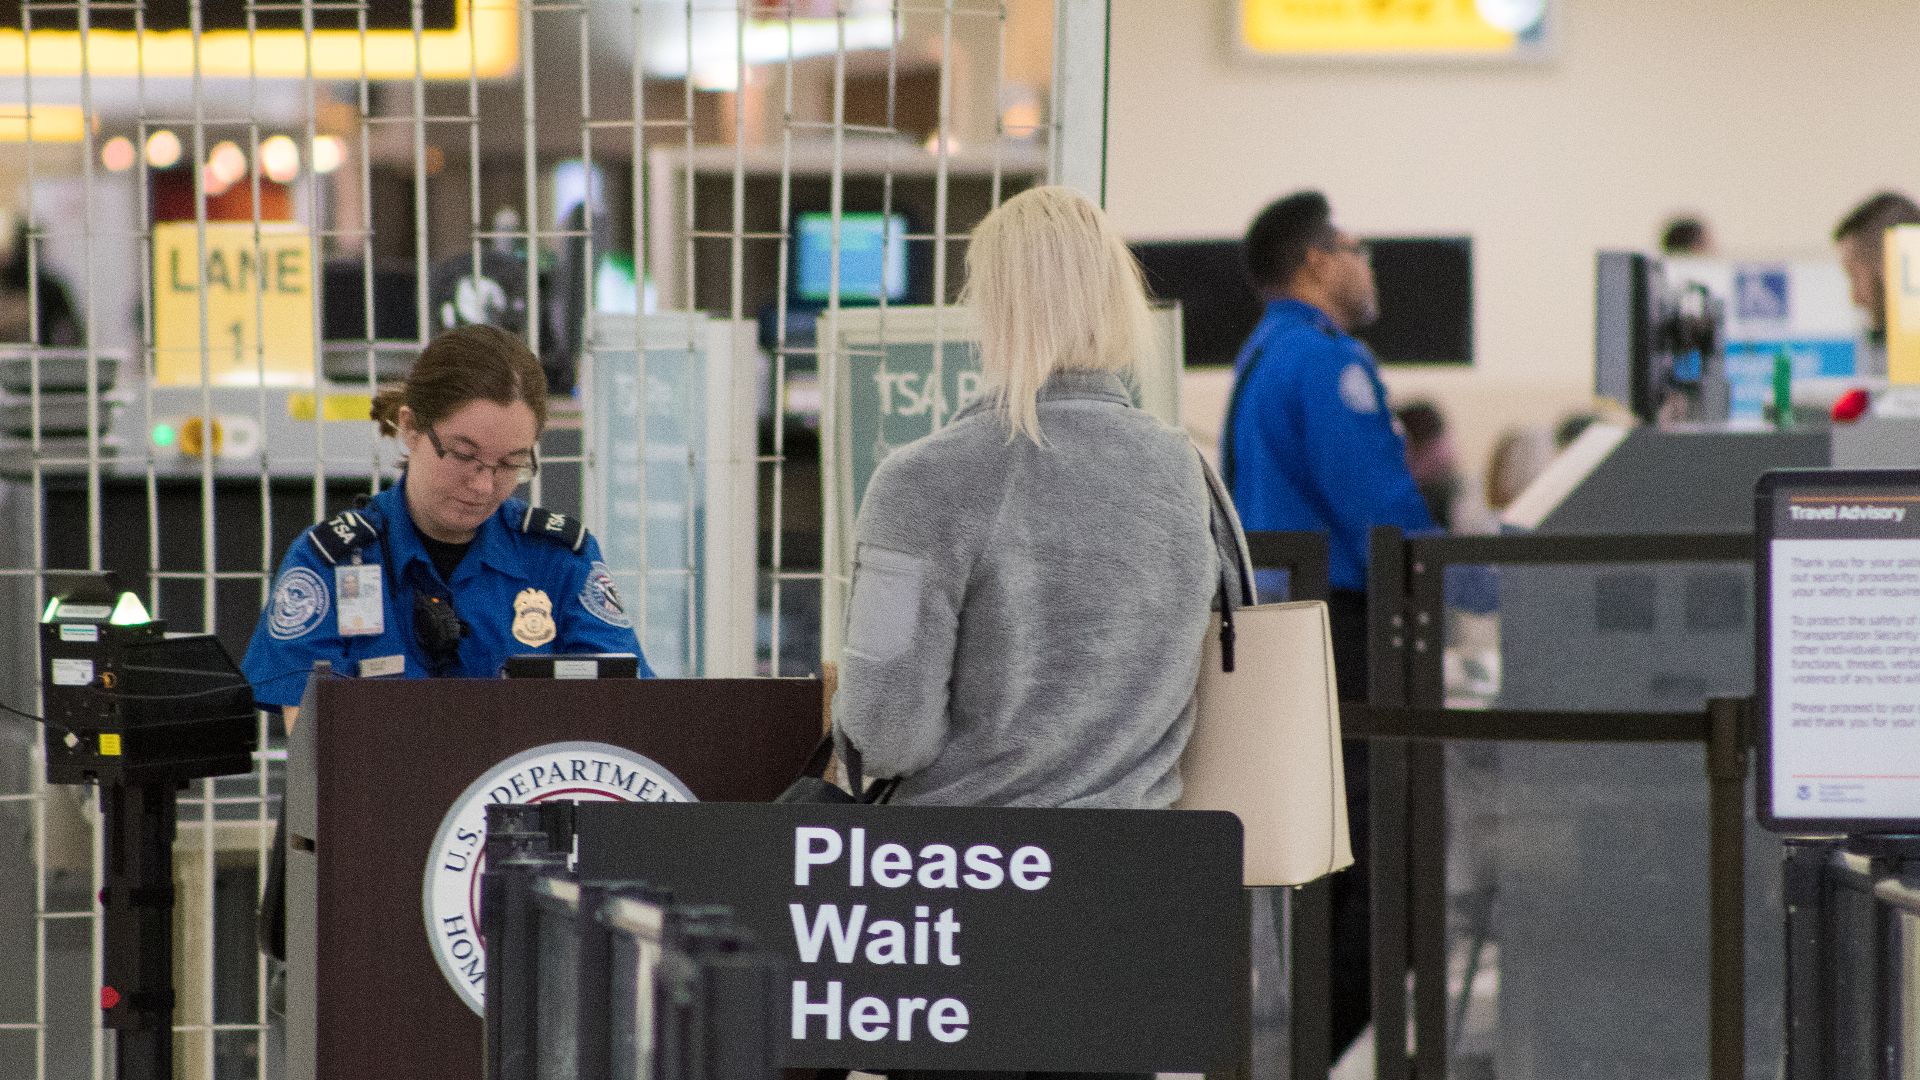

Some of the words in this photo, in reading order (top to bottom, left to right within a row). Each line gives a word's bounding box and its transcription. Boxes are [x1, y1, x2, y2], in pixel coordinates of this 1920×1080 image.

[170, 248, 303, 293] LANE
[226, 320, 244, 361] 1
[872, 371, 950, 416] TSA
[957, 370, 983, 412] P
[544, 512, 567, 532] TSA
[1789, 505, 1837, 520] Travel
[1838, 505, 1906, 523] Advisory
[327, 515, 358, 545] TSA
[1791, 557, 1824, 568] Thank
[1827, 559, 1848, 569] you
[1850, 557, 1864, 568] for
[1870, 559, 1893, 569] your
[1812, 572, 1853, 583] security
[1857, 572, 1918, 583] procedures
[1791, 588, 1814, 597] your
[1819, 586, 1852, 597] safety
[1856, 586, 1876, 596] and
[1791, 615, 1804, 626] To
[1806, 616, 1846, 627] protect
[1848, 615, 1866, 626] the
[1869, 615, 1902, 627] safety
[1905, 615, 1917, 626] of
[1791, 630, 1871, 640] Transportation
[1874, 630, 1918, 641] Security
[1791, 645, 1819, 655] other
[1823, 645, 1882, 655] individuals
[1791, 675, 1836, 684] violence
[1839, 674, 1851, 684] of
[1876, 674, 1902, 684] kind
[1791, 702, 1826, 713] Please
[1829, 703, 1873, 714] proceed
[1876, 703, 1887, 713] to
[1891, 704, 1915, 714] your
[1791, 718, 1812, 728] and
[1815, 717, 1844, 728] thank
[1849, 719, 1869, 729] you
[1872, 717, 1887, 728] for
[1892, 719, 1915, 729] your
[444, 826, 484, 873] U.S.
[489, 759, 677, 803] DEPARTMEN
[794, 826, 1052, 891] Please
[789, 903, 961, 966] Wait
[443, 914, 486, 987] HOM
[791, 980, 970, 1043] Here
